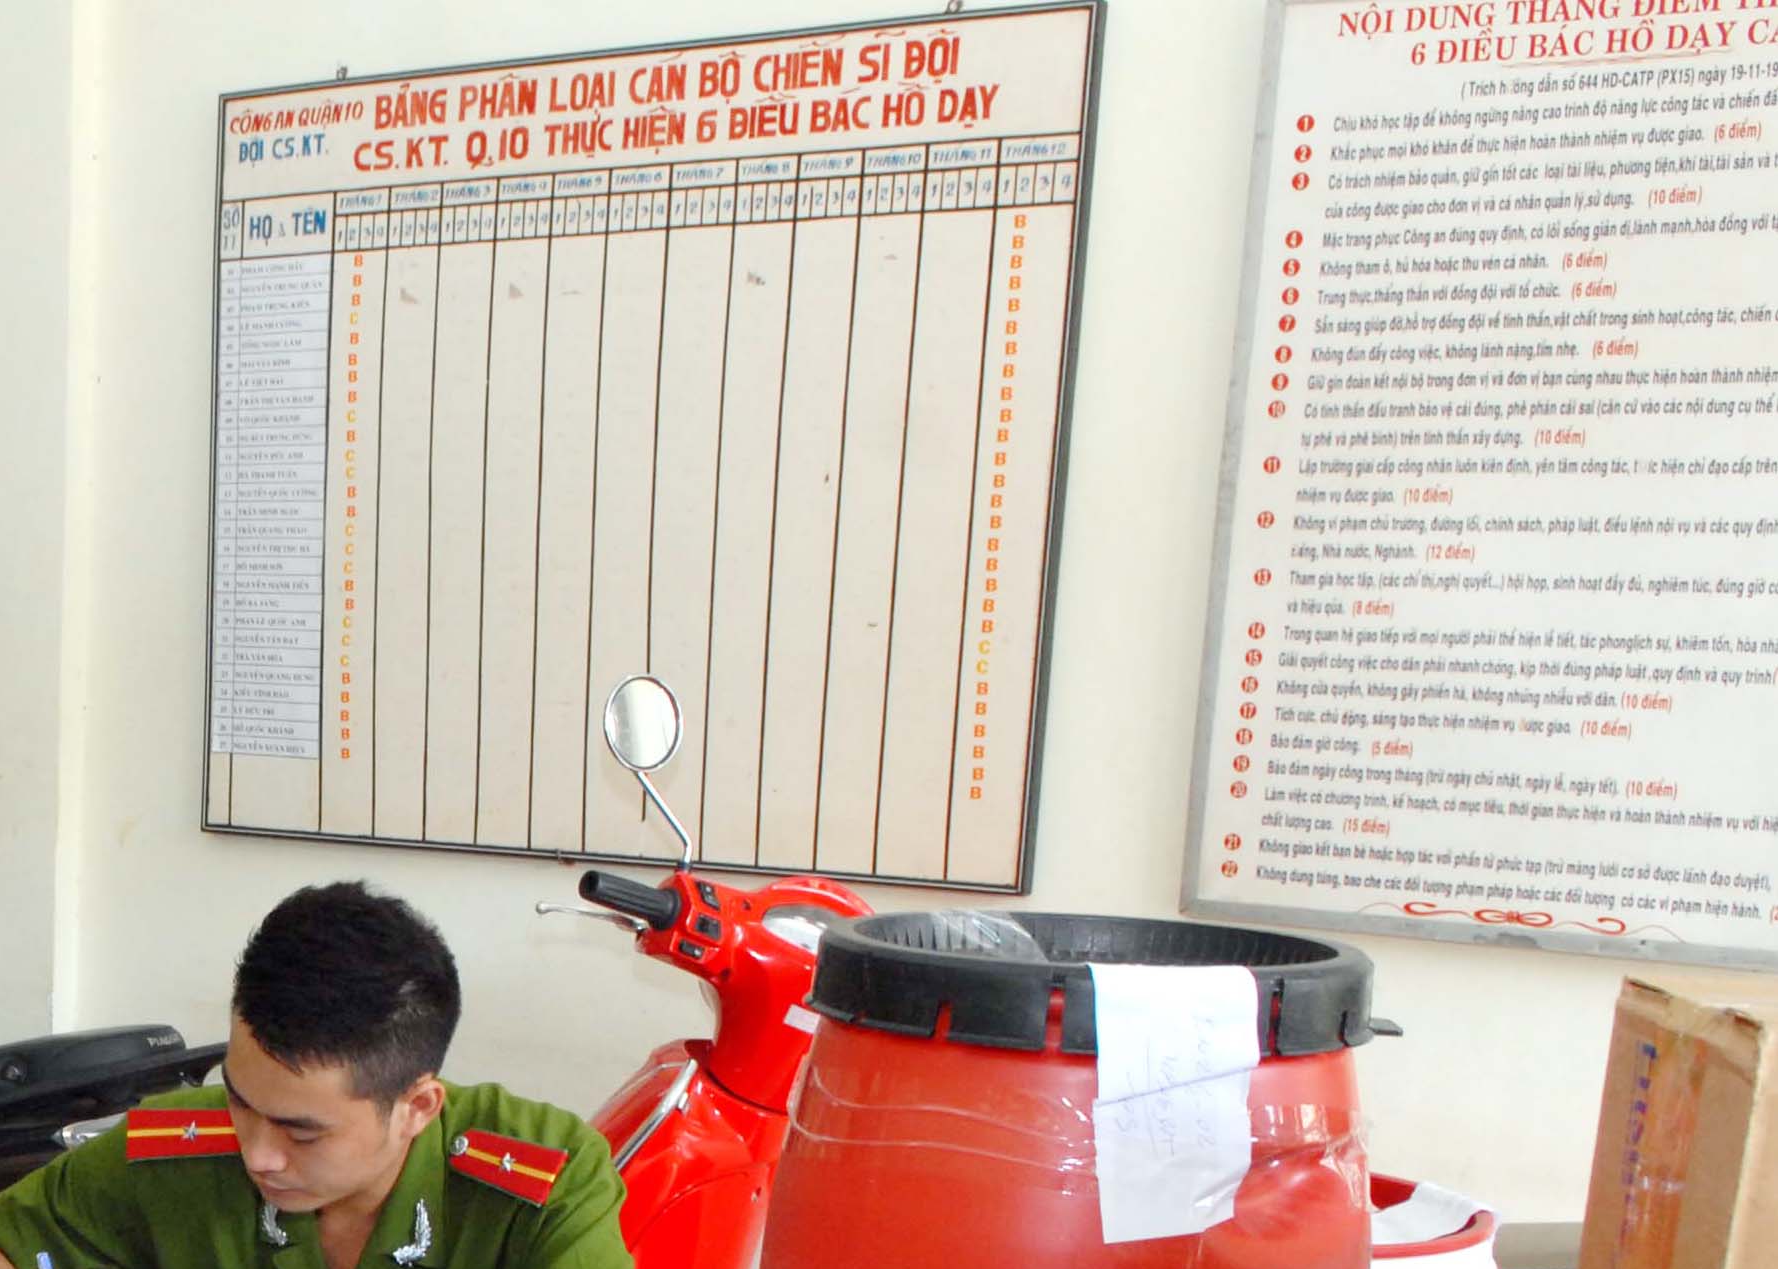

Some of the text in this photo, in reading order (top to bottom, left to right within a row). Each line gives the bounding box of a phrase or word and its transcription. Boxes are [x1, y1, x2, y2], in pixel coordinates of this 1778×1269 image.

[1338, 3, 1396, 40] NỘI
[1404, 2, 1496, 33] DUNG
[1410, 42, 1427, 66] 6
[1434, 28, 1518, 65] ĐIỀU
[1527, 24, 1595, 60] BÁC
[1604, 17, 1655, 55] HỒ
[1665, 20, 1737, 56] DẠY
[374, 28, 962, 131] BẢNG PHÂN LOẠI CÁN BỘ CHIẾN SĨ ĐỘI
[1536, 75, 1561, 93] dẫn
[1560, 74, 1578, 92] số
[1576, 74, 1601, 90] 644
[1599, 70, 1656, 88] HD-CATP
[1655, 68, 1697, 86] (PX15)
[1696, 69, 1729, 86] ngày
[229, 100, 365, 135] CÔNG AN QUẬN 10
[543, 115, 613, 160] THỰC
[622, 104, 688, 155] HIỆN
[696, 109, 718, 144] 6
[729, 91, 800, 141] ĐIỀU
[809, 87, 871, 133] BÁC
[881, 82, 929, 130] HỒ
[937, 83, 1000, 129] DẠY
[238, 135, 264, 168] ĐỘI
[248, 215, 273, 246] HỌ
[291, 206, 328, 236] TÊN
[1014, 215, 1027, 229] B
[1012, 235, 1025, 250] B
[1010, 255, 1022, 269] B
[1008, 275, 1021, 290] B
[1008, 298, 1020, 313] B
[1006, 321, 1018, 335] B
[1005, 341, 1017, 356] B
[1002, 364, 1015, 379] B
